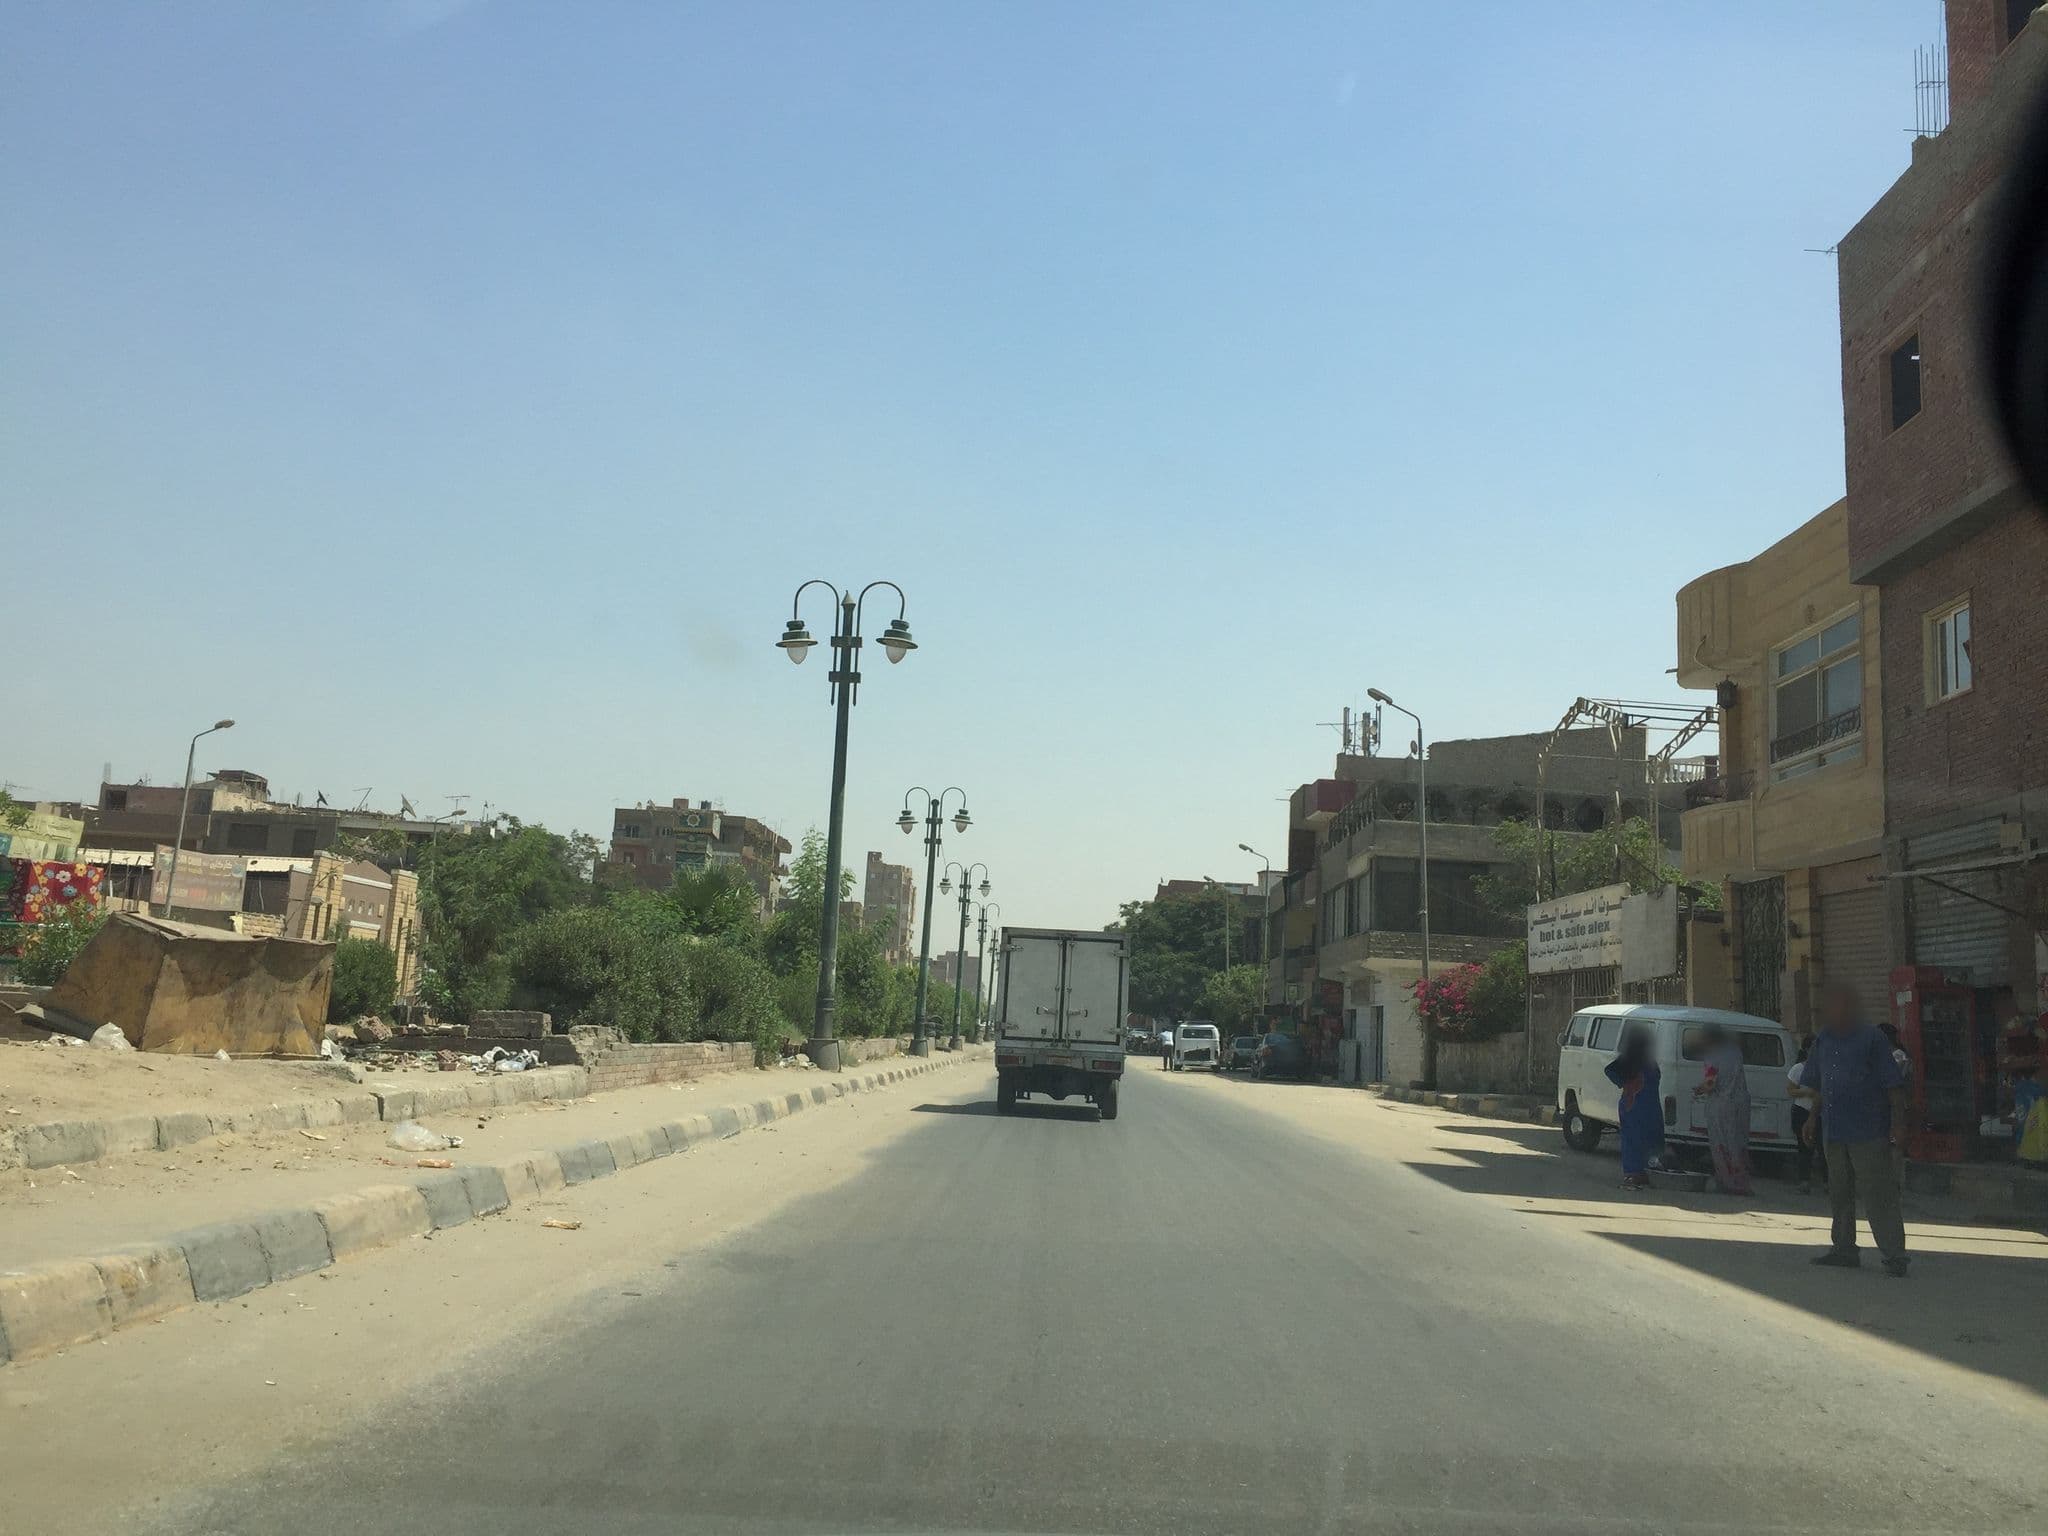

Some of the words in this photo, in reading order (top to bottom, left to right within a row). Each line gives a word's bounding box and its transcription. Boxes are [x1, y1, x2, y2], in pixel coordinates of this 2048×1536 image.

[1557, 928, 1564, 939] &
[1565, 924, 1586, 938] safe
[1588, 920, 1610, 934] alex
